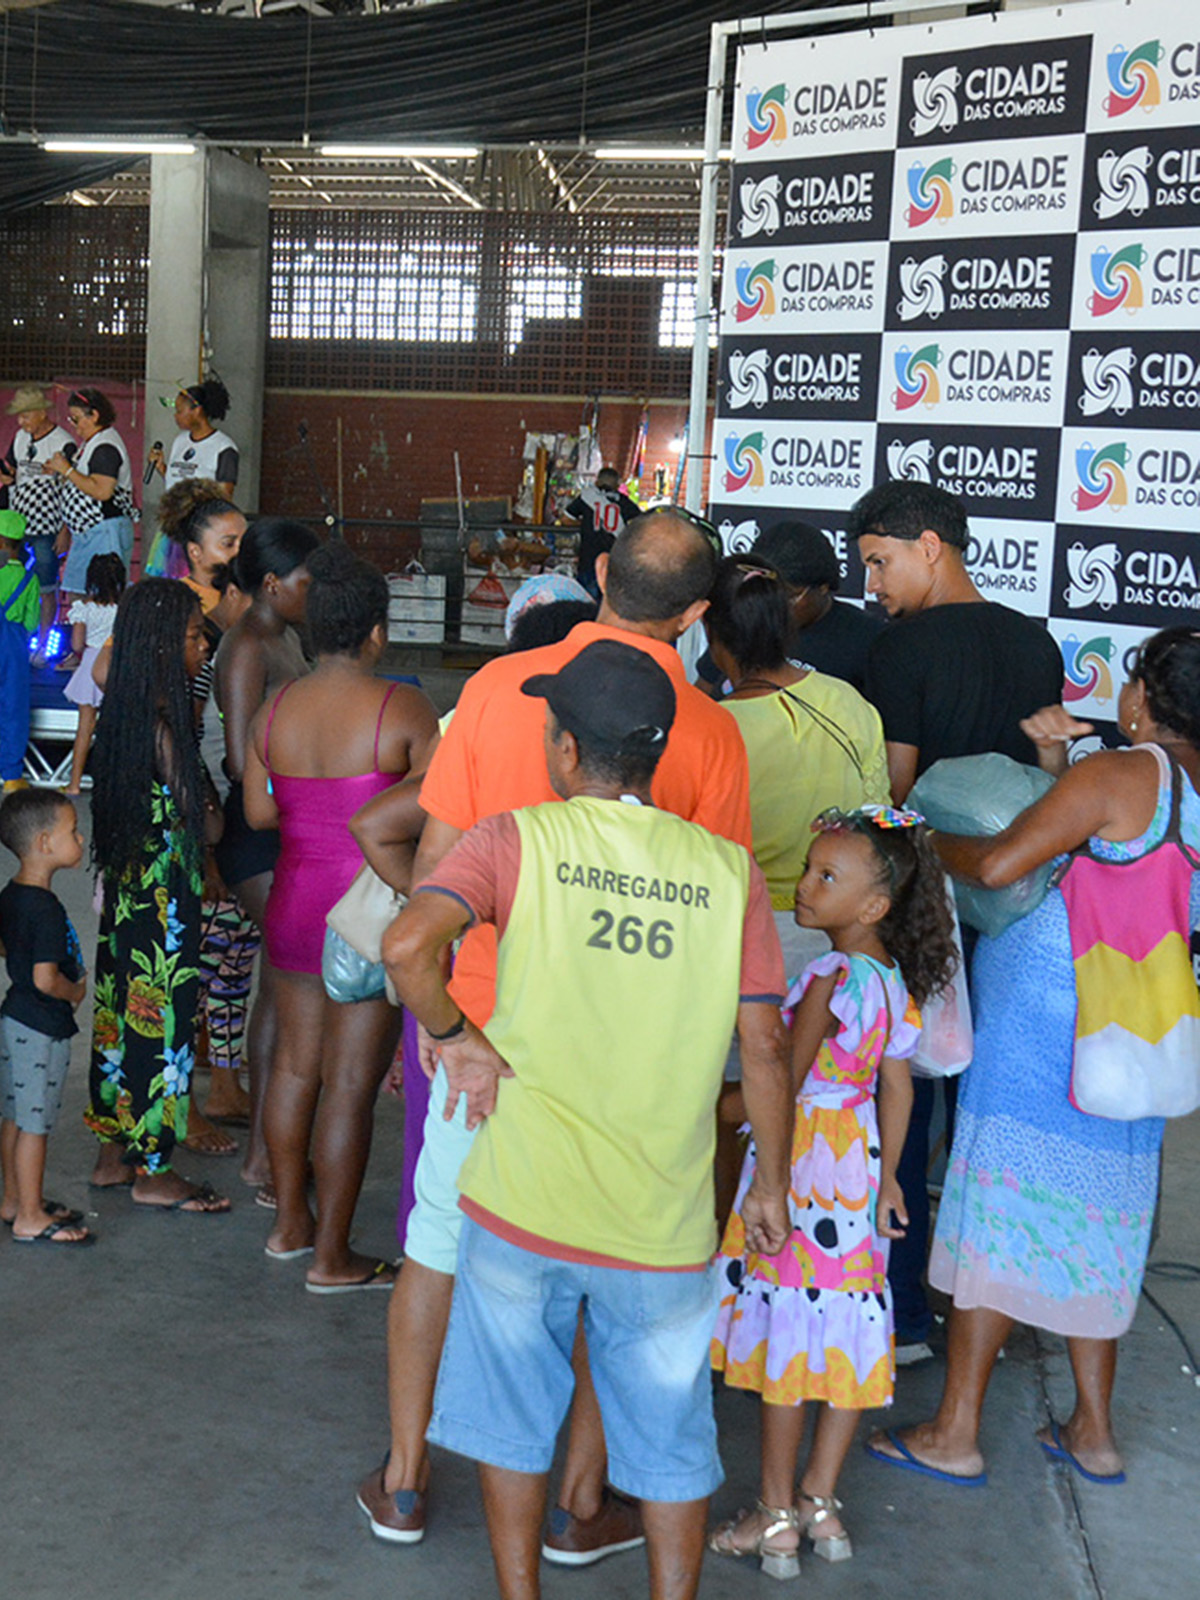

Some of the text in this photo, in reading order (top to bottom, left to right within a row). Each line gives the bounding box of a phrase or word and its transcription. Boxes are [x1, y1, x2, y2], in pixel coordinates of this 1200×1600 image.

[965, 60, 1068, 101] CIDADE
[1168, 82, 1200, 102] DAS
[794, 77, 888, 112] CIDADE
[964, 96, 1065, 121] DAS COMPRAS
[793, 112, 886, 137] DAS COMPRAS
[962, 155, 1068, 193] CIDADE
[785, 172, 874, 208] CIDADE
[960, 192, 1066, 214] DAS COMPRAS
[1156, 187, 1187, 206] DAS
[784, 205, 872, 226] DAS COMPRAS
[783, 260, 875, 293] CIDADE
[951, 256, 1052, 290] CIDADE
[1153, 248, 1200, 283] CID
[781, 294, 873, 313] DAS COMPRAS
[950, 291, 1050, 310] DAS COMPRAS
[1151, 287, 1183, 305] DAS
[774, 353, 861, 383] CIDADE
[948, 350, 1053, 382] CIDADE
[773, 385, 860, 401] DAS COMPRAS
[947, 385, 1051, 403] DAS COMPRAS
[1139, 389, 1170, 407] DAS
[771, 438, 862, 469] CIDADE
[938, 446, 1037, 480] CIDADE
[770, 470, 861, 489] DAS COMPRAS
[937, 478, 1035, 499] DAS COMPRAS
[1135, 487, 1166, 505] DAS
[594, 501, 620, 532] 10
[963, 536, 1039, 572] DADE
[1125, 551, 1197, 588] CIDA
[1124, 586, 1154, 605] DAS
[556, 862, 710, 909] CARREGADOR
[586, 909, 674, 959] 266
